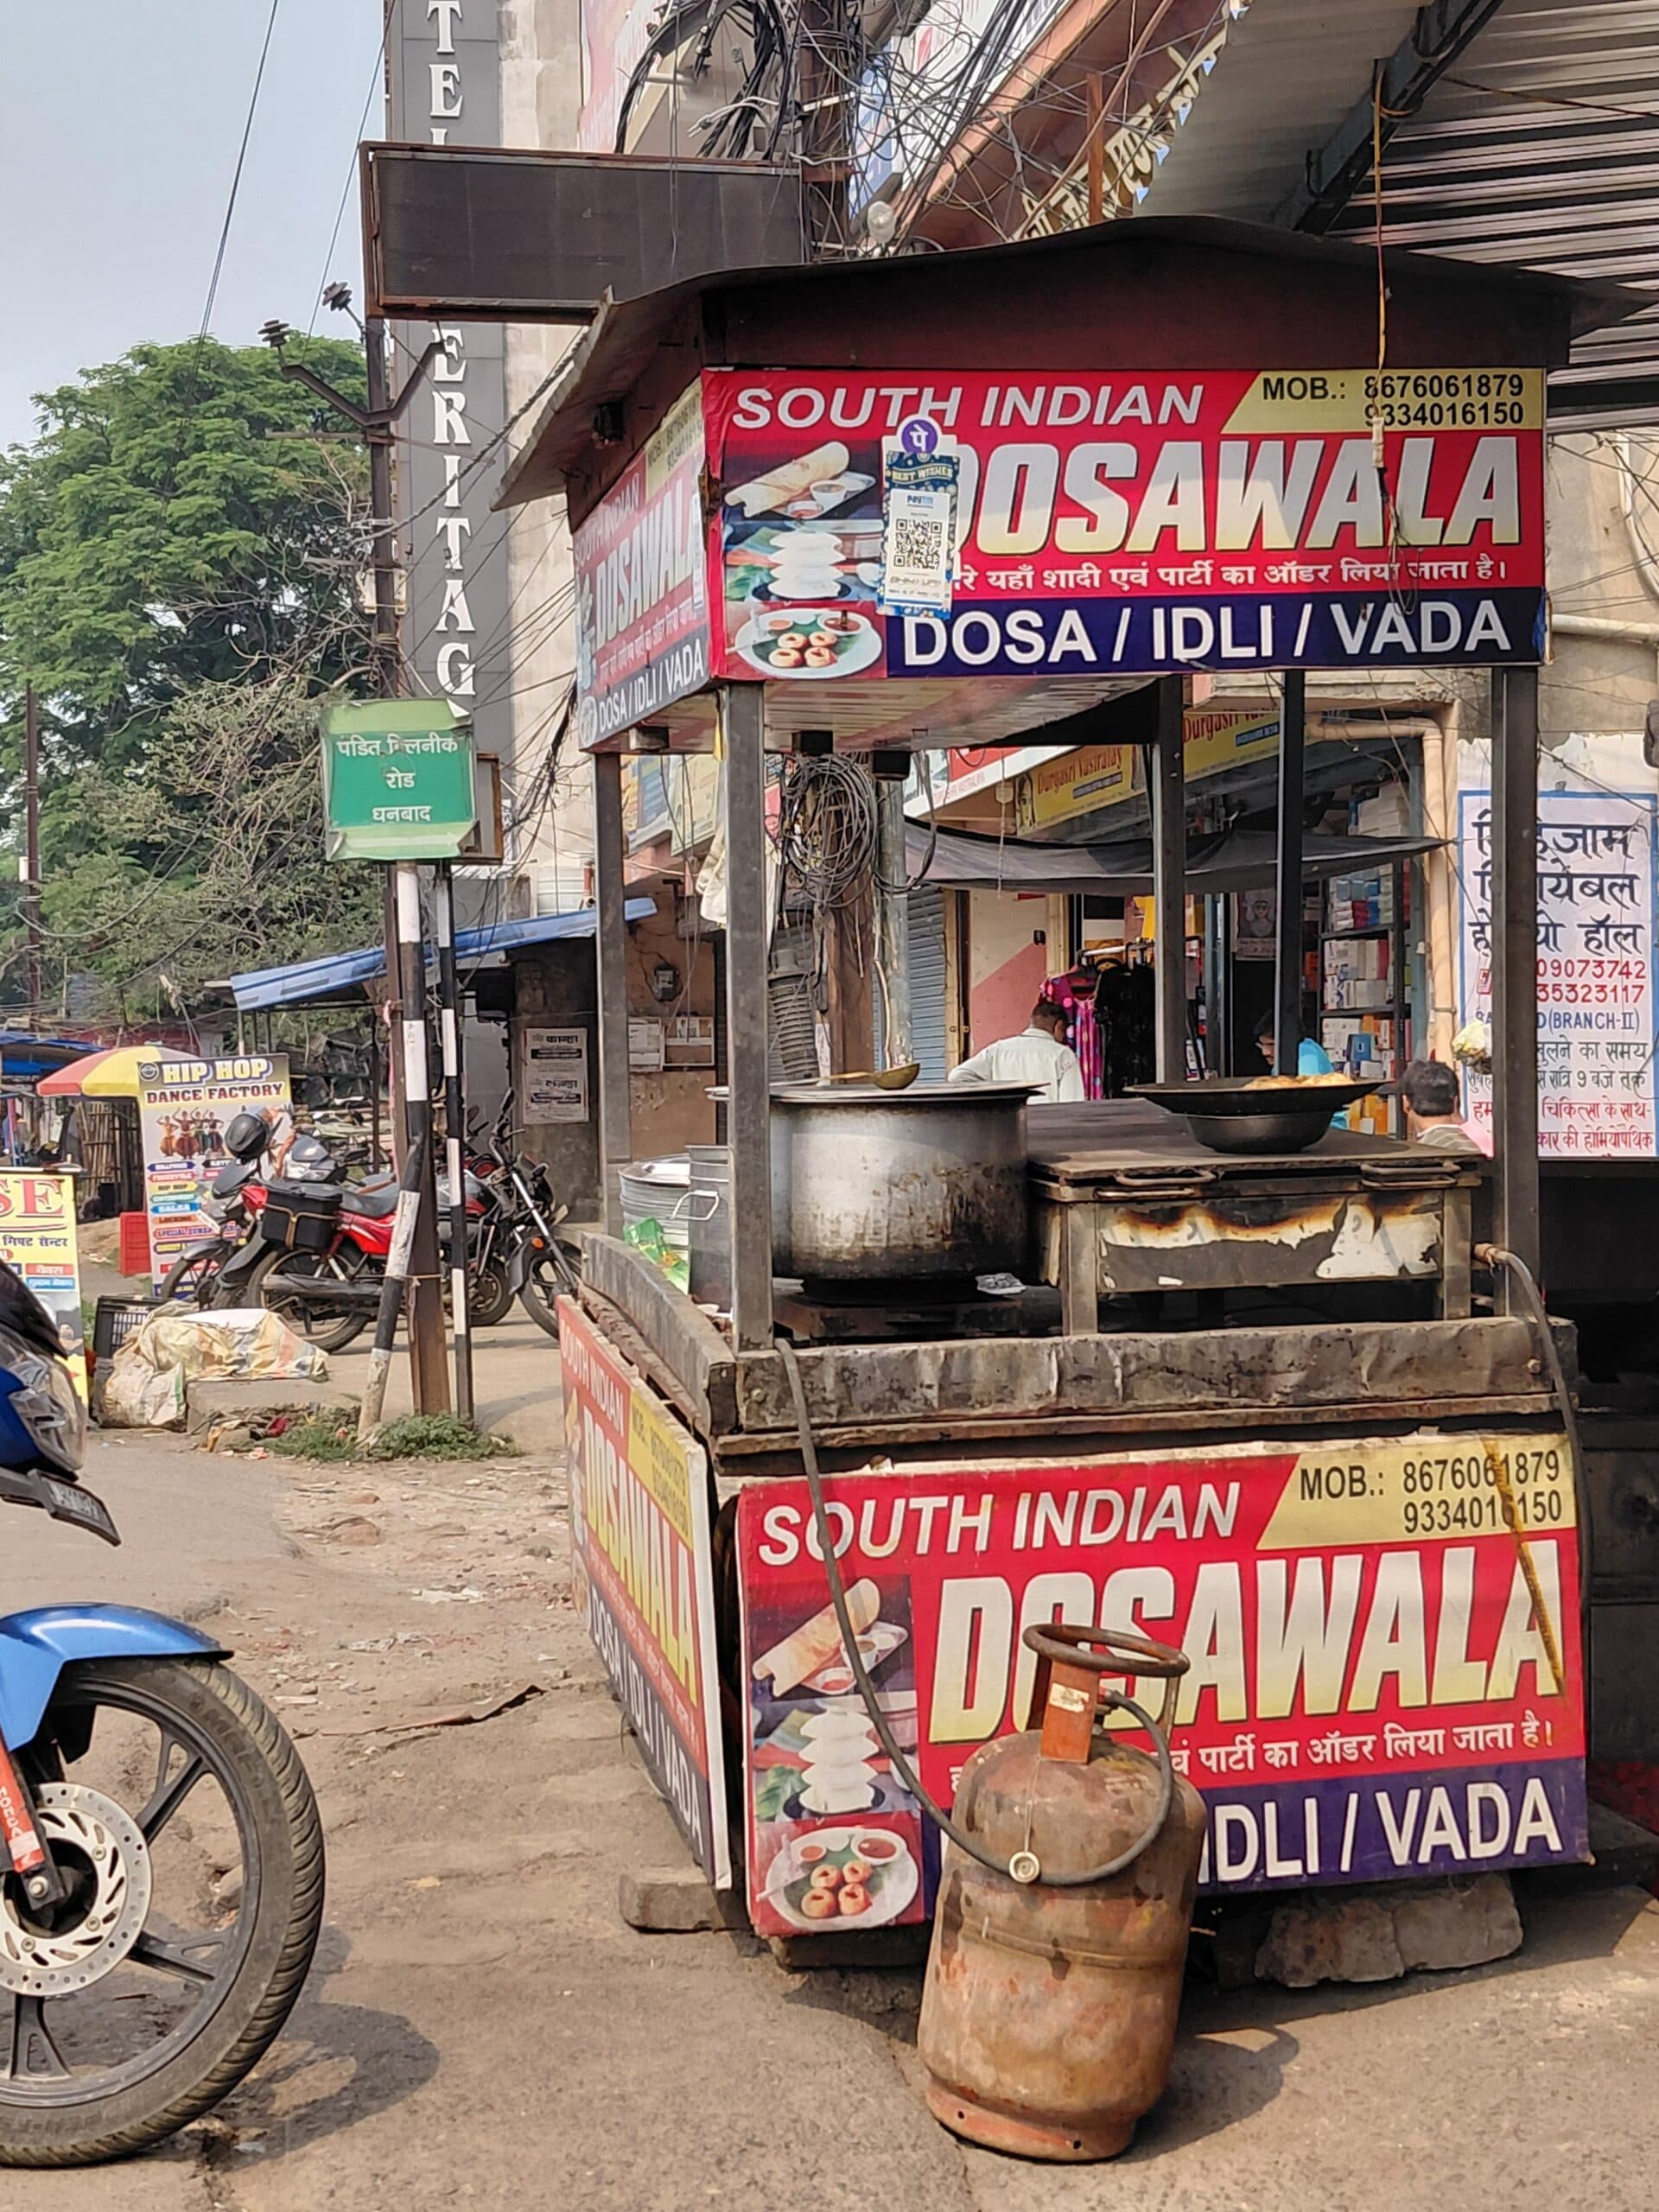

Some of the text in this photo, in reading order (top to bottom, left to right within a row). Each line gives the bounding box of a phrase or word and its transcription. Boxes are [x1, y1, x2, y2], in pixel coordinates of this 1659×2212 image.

[733, 387, 962, 429] SOUTH
[981, 385, 1204, 427] INDIAN
[1364, 374, 1524, 399] 8676061879
[1364, 402, 1524, 427] 9334016150
[987, 563, 1034, 590] यहाँ
[1043, 563, 1102, 590] शादी
[1108, 561, 1149, 591] एवं
[1157, 559, 1214, 587] पार्टी
[1221, 565, 1255, 586] का
[1341, 557, 1400, 582] लिया
[905, 610, 1096, 666] DOSA
[1153, 603, 1274, 661] IDLI
[1330, 598, 1512, 656] VADA
[599, 683, 627, 733] DOSA
[633, 669, 657, 715] IDLI
[664, 638, 704, 696] VADA
[385, 766, 415, 788] रोड
[1577, 913, 1646, 957] हॉल
[162, 1058, 272, 1086] HIP HOP
[1578, 1042, 1601, 1061] का
[1605, 1042, 1649, 1064] समय
[146, 1083, 283, 1104] DANCE FACTORY
[1577, 1070, 1587, 1088] 9
[1590, 1065, 1616, 1090] बजे
[1619, 1069, 1648, 1091] तक
[1602, 1094, 1618, 1121] के
[760, 1493, 994, 1567] SOUTH
[1012, 1482, 1241, 1551] INDIAN
[1403, 1450, 1560, 1494] 8676061879
[583, 1404, 698, 1709] DOSAWALA
[1198, 1733, 1255, 1770] पार्टी
[1263, 1740, 1299, 1769] का
[1383, 1723, 1446, 1758] लिया
[1453, 1719, 1514, 1751] जाता
[659, 1712, 704, 1858] VADA
[1375, 1777, 1564, 1867] VADA
